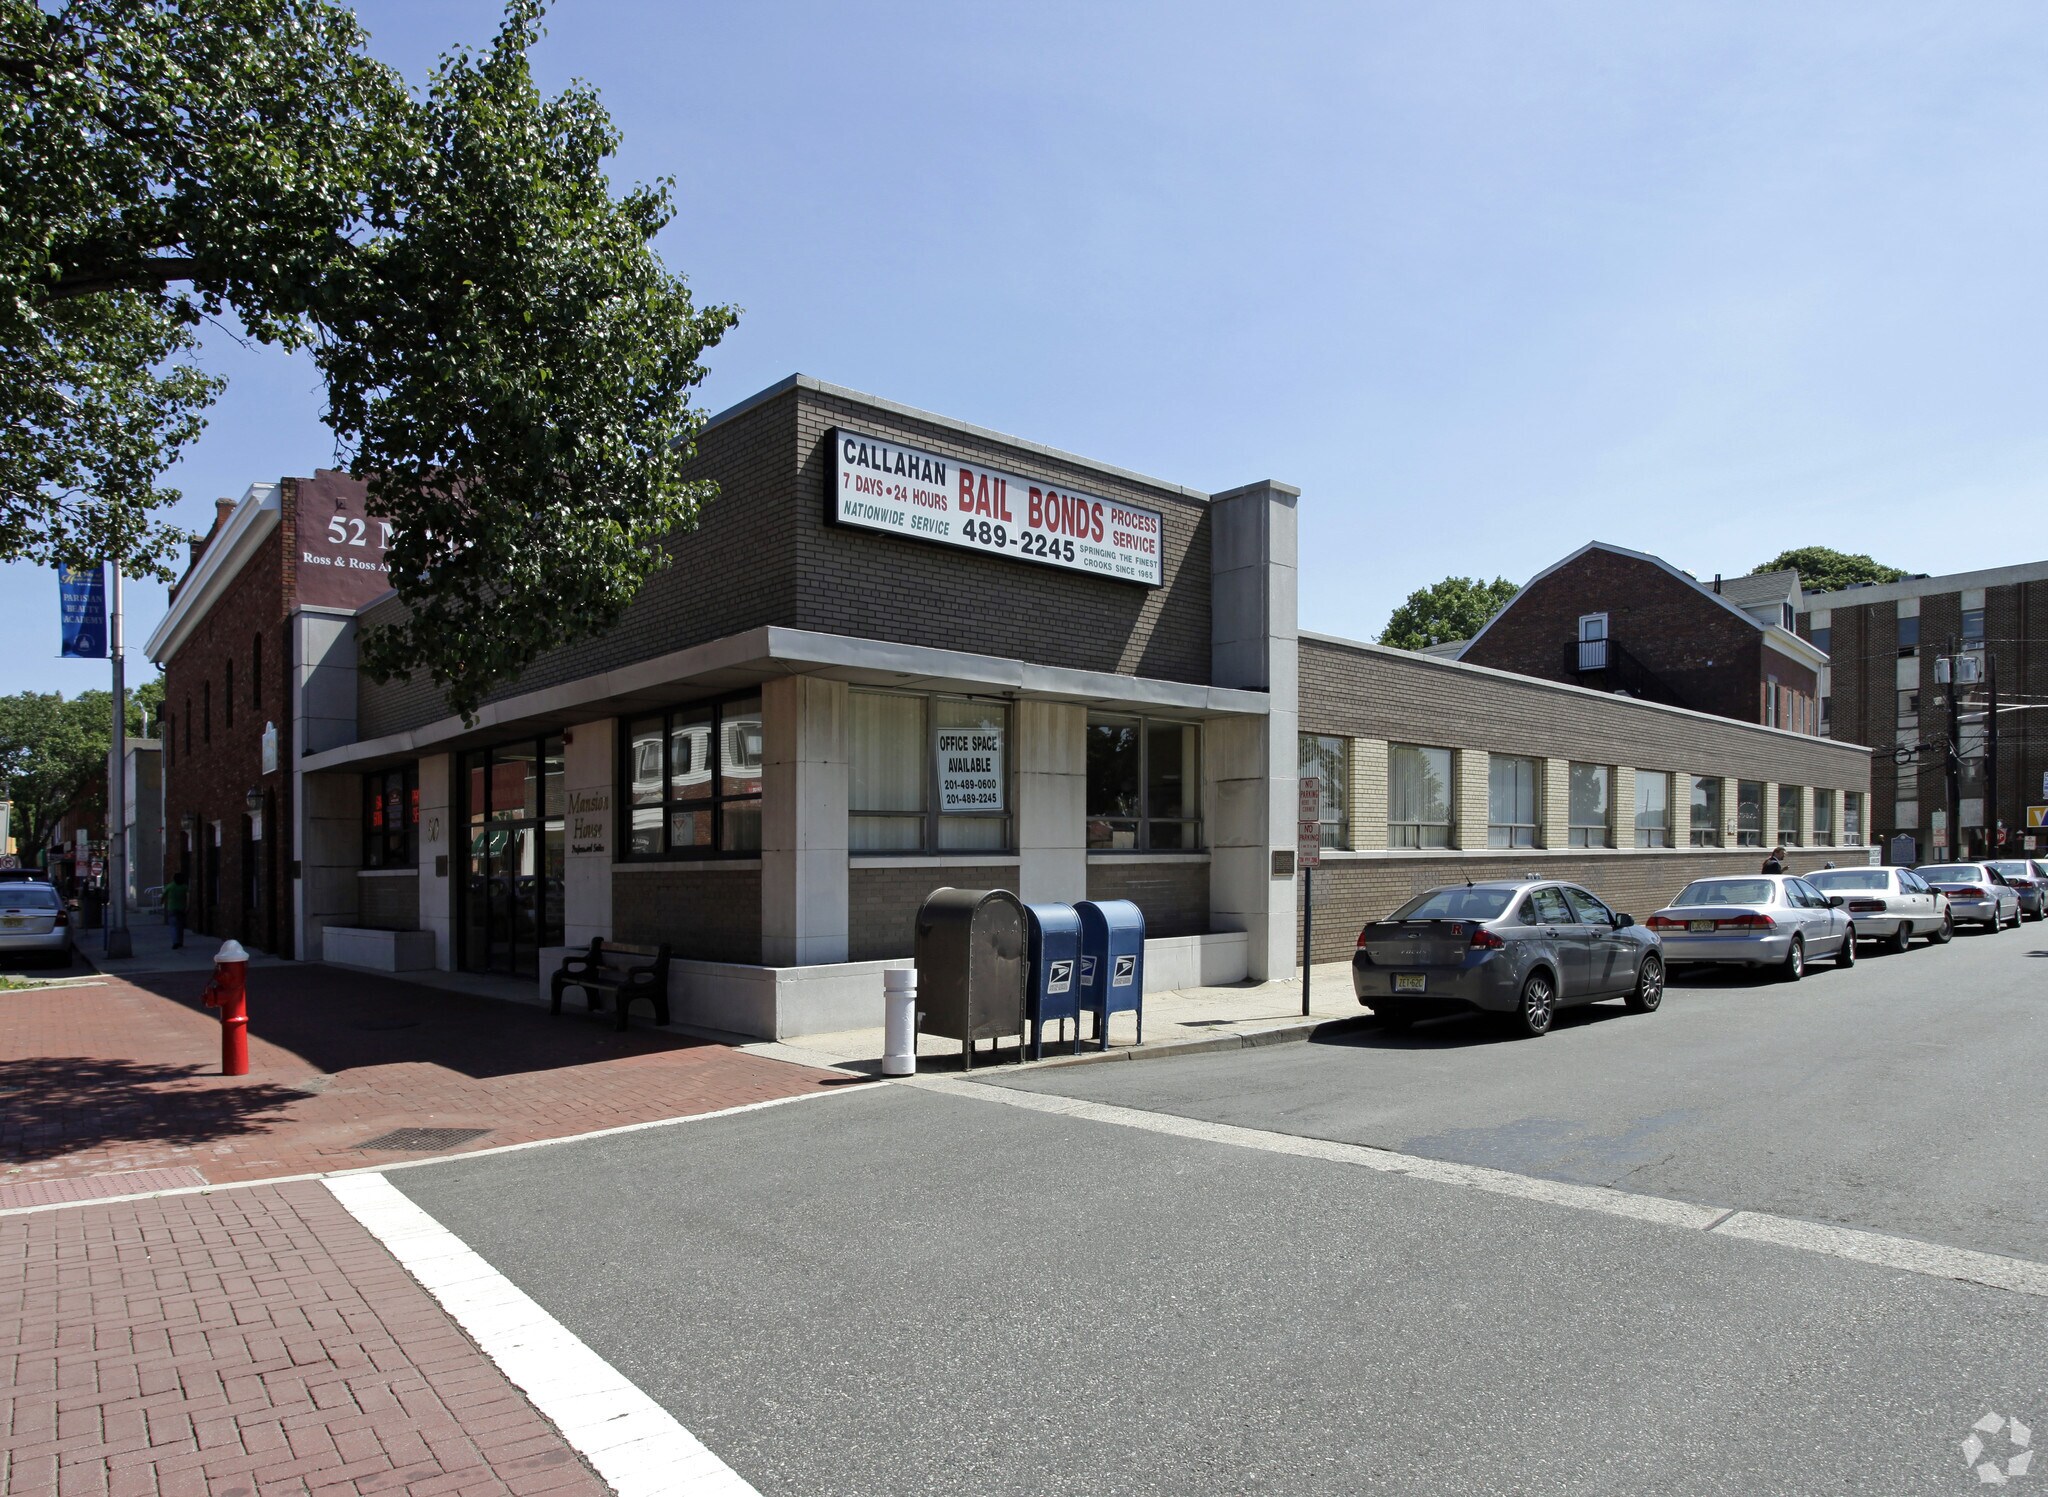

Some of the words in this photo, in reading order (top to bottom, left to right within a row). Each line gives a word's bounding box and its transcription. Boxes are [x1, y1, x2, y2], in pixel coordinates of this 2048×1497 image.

[843, 439, 946, 486] CALLAHAN
[843, 472, 850, 489] 7
[912, 487, 948, 512] HOURS
[959, 467, 1012, 523] BAIL
[1028, 486, 1104, 543] BONDS
[843, 500, 905, 527] NATIONWIDE
[910, 514, 950, 536] SERVICE
[1111, 507, 1157, 534] PROCESS
[327, 515, 367, 547] 52
[962, 518, 1075, 563] 489-2245
[1112, 530, 1156, 555] SERVICE
[302, 551, 331, 566] Ross
[334, 556, 346, 568] &
[349, 557, 376, 571] Ross
[1079, 544, 1117, 560] SPRINGING
[1119, 553, 1133, 564] THE
[1135, 556, 1158, 569] FINEST
[1083, 557, 1113, 571] CROOKS
[1115, 564, 1136, 576] SINCE
[63, 593, 103, 603] PARISIAN
[63, 615, 104, 624] ACADEMY
[939, 735, 969, 752] OFFICE
[972, 735, 998, 751] SPACE
[948, 757, 991, 773] AVAILABLE
[944, 779, 997, 790] 201-489-0600
[1300, 790, 1318, 799] PARKING
[1305, 779, 1313, 789] NO
[567, 791, 609, 815] Mansion
[946, 793, 997, 804] 201-489-2245
[427, 816, 440, 843] 50
[573, 817, 603, 840] House
[1304, 824, 1313, 833] NO
[1451, 924, 1463, 936] R
